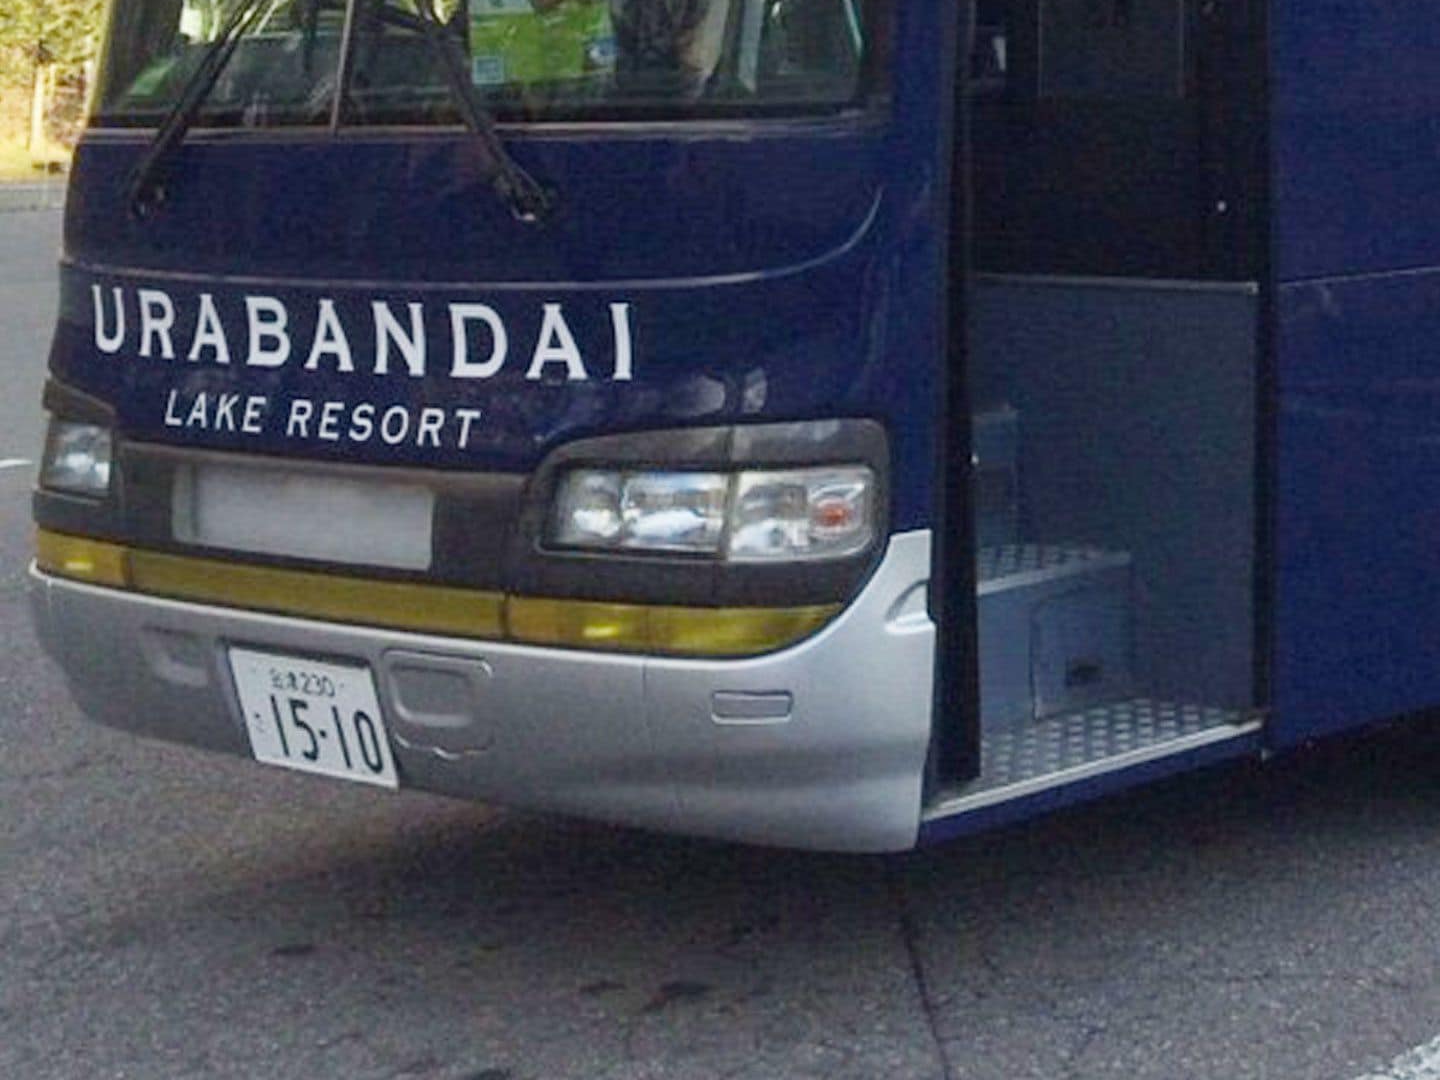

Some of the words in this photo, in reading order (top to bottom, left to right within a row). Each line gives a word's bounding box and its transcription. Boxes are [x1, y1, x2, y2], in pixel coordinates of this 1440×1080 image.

[91, 283, 633, 381] URABANDAI
[164, 388, 266, 435] LAKE
[286, 398, 482, 450] RESORT
